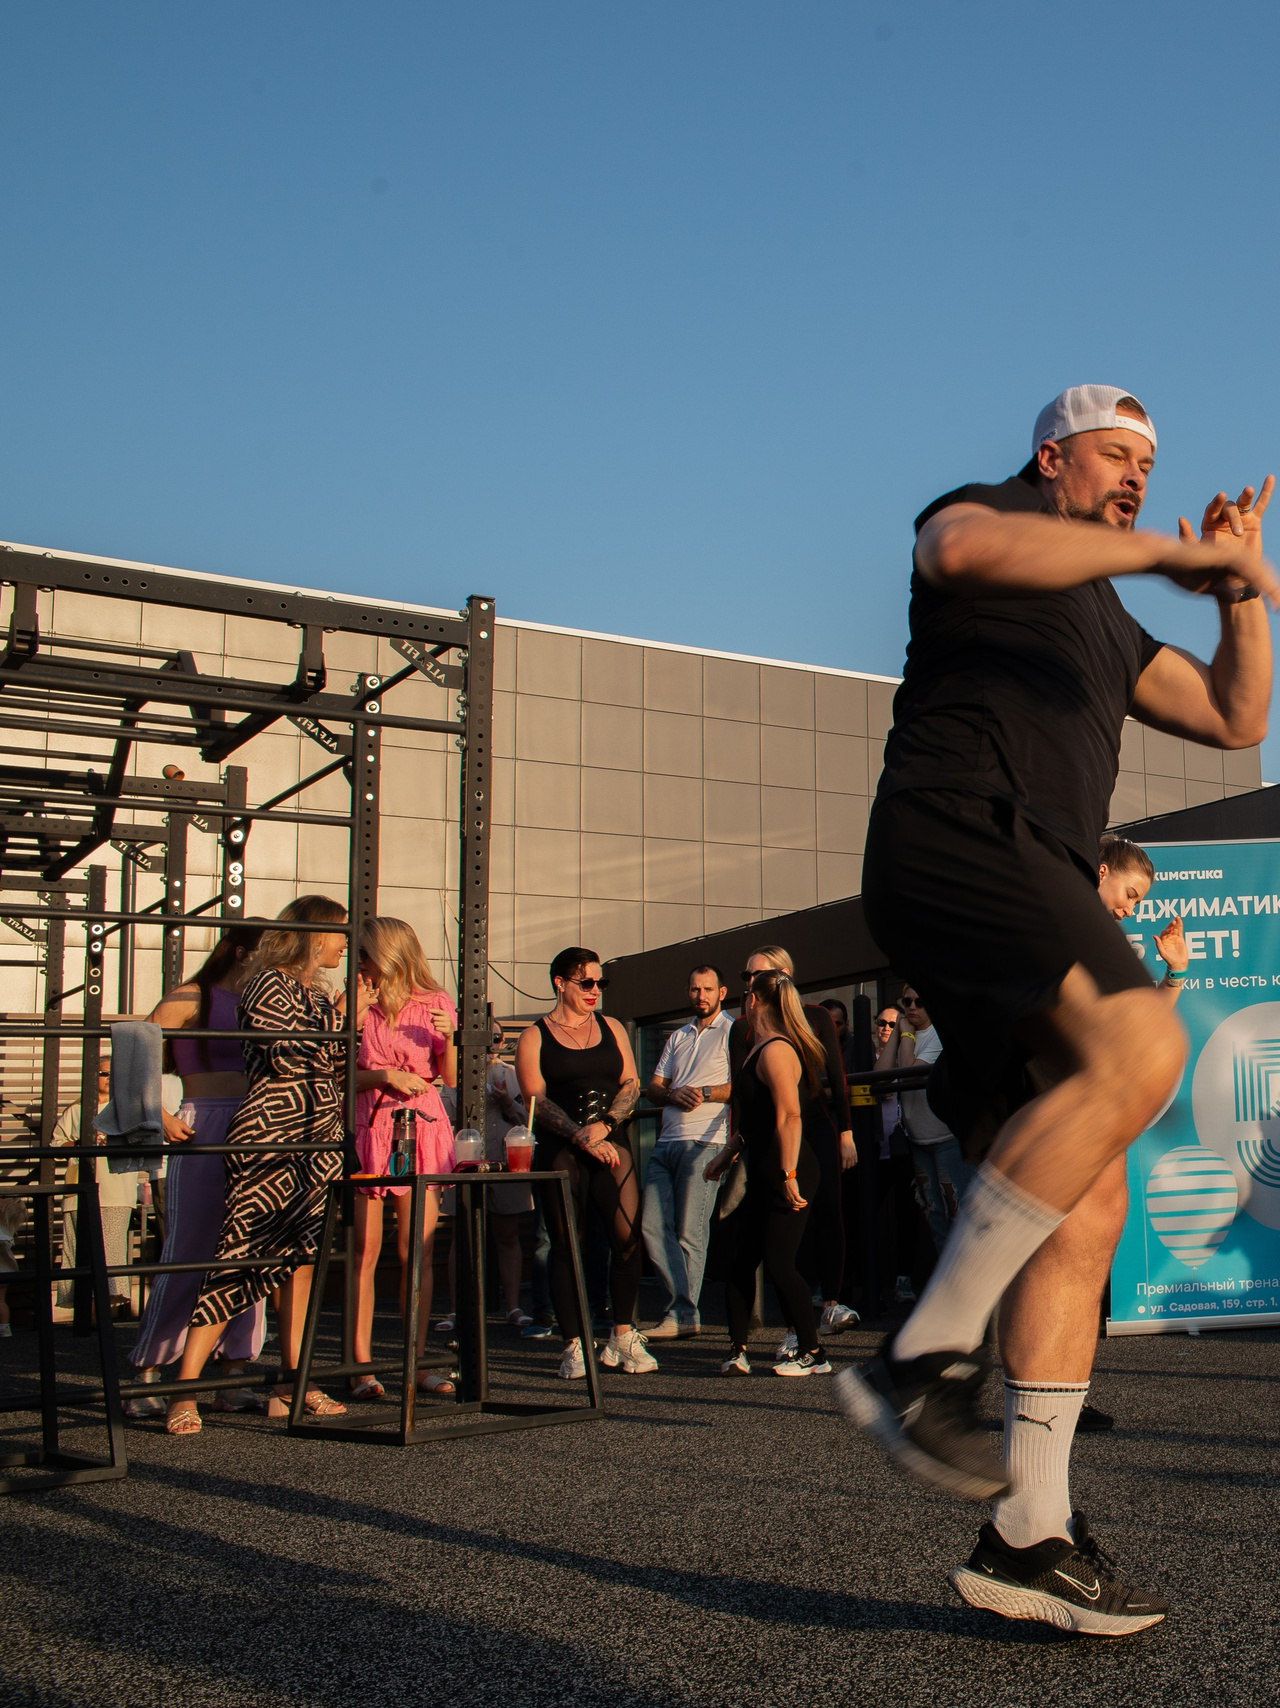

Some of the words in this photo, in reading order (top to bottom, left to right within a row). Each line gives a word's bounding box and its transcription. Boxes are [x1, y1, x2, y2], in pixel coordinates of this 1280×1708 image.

[1155, 930, 1240, 962] ЕТ!
[1205, 978, 1215, 989] в
[1219, 974, 1267, 988] честь
[1137, 1278, 1235, 1297] Премиальный
[1150, 1305, 1167, 1315] ул.
[1169, 1300, 1219, 1313] Садовая,
[1221, 1299, 1243, 1310] 159,
[1245, 1299, 1267, 1310] стр.
[1270, 1297, 1279, 1307] 1,
